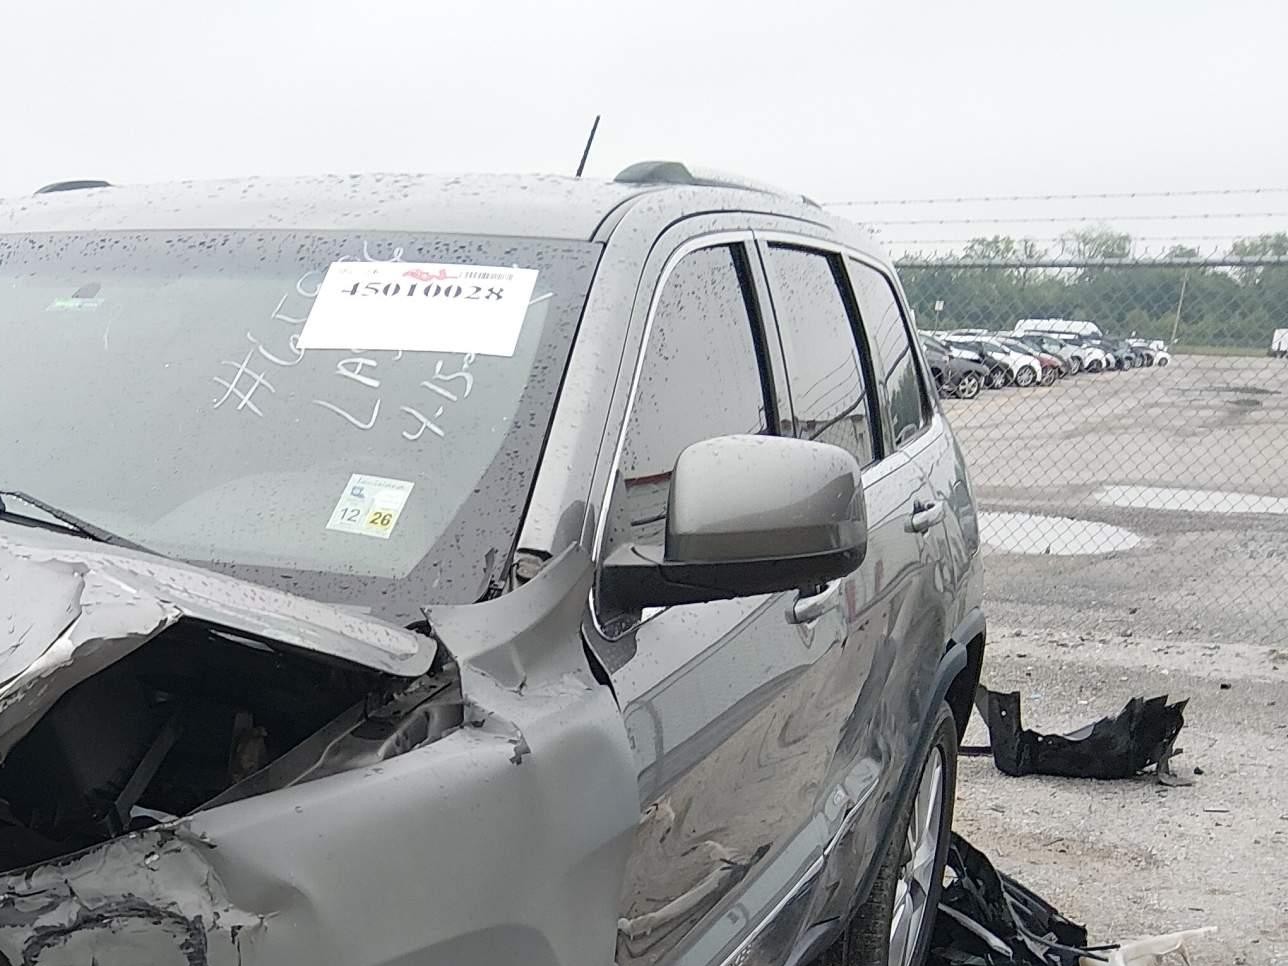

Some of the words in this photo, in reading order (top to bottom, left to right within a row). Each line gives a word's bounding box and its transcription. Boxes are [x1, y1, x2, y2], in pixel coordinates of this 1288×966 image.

[341, 280, 505, 301] 45010028
[340, 506, 362, 522] 12
[368, 511, 393, 526] 26
